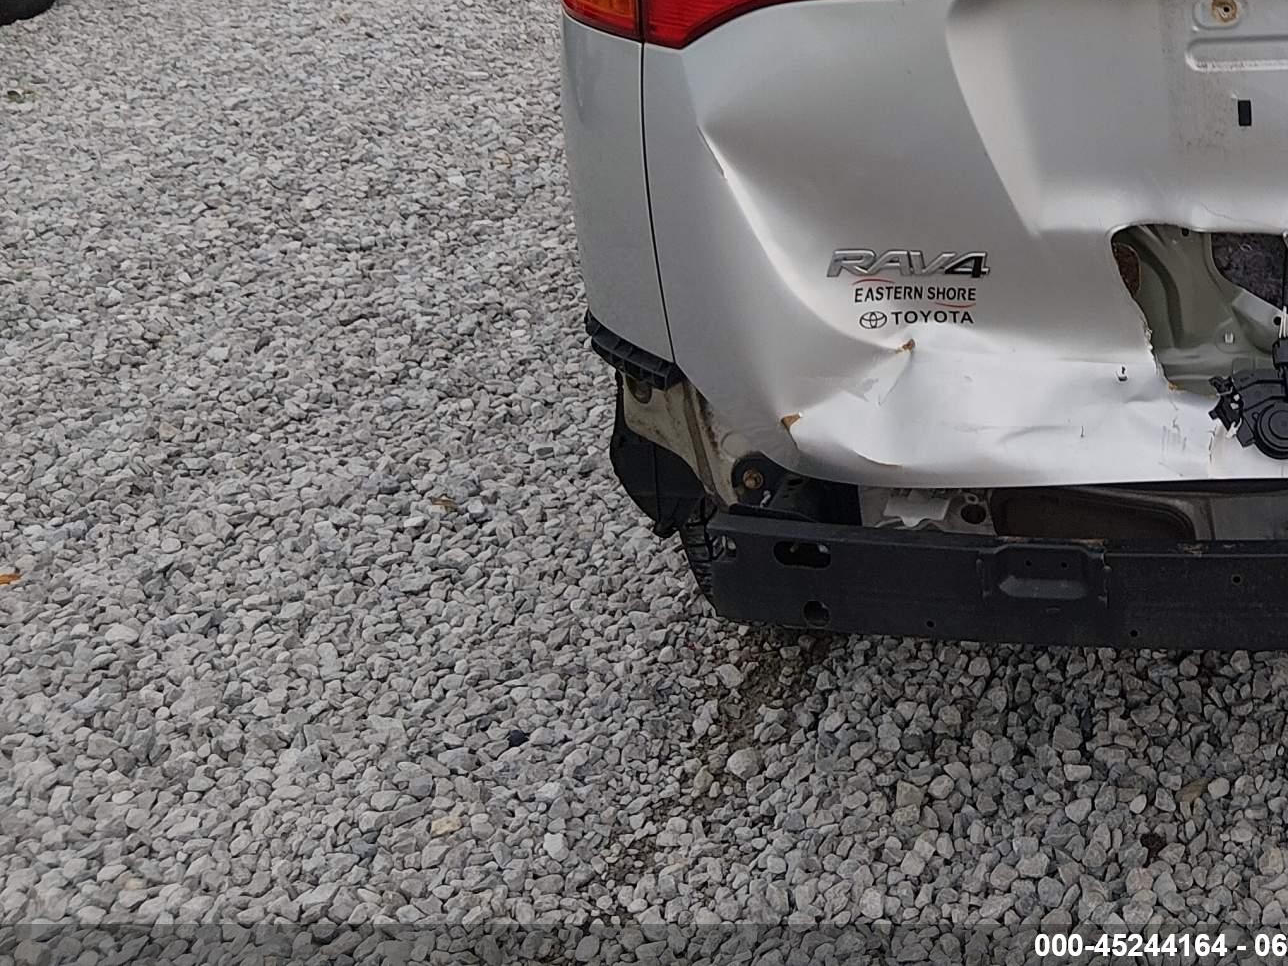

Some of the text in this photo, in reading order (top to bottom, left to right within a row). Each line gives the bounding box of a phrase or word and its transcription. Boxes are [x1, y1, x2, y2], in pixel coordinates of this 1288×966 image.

[827, 248, 990, 278] RAV4
[854, 286, 976, 303] EASTERN SHORE
[891, 310, 974, 325] TOYOTA
